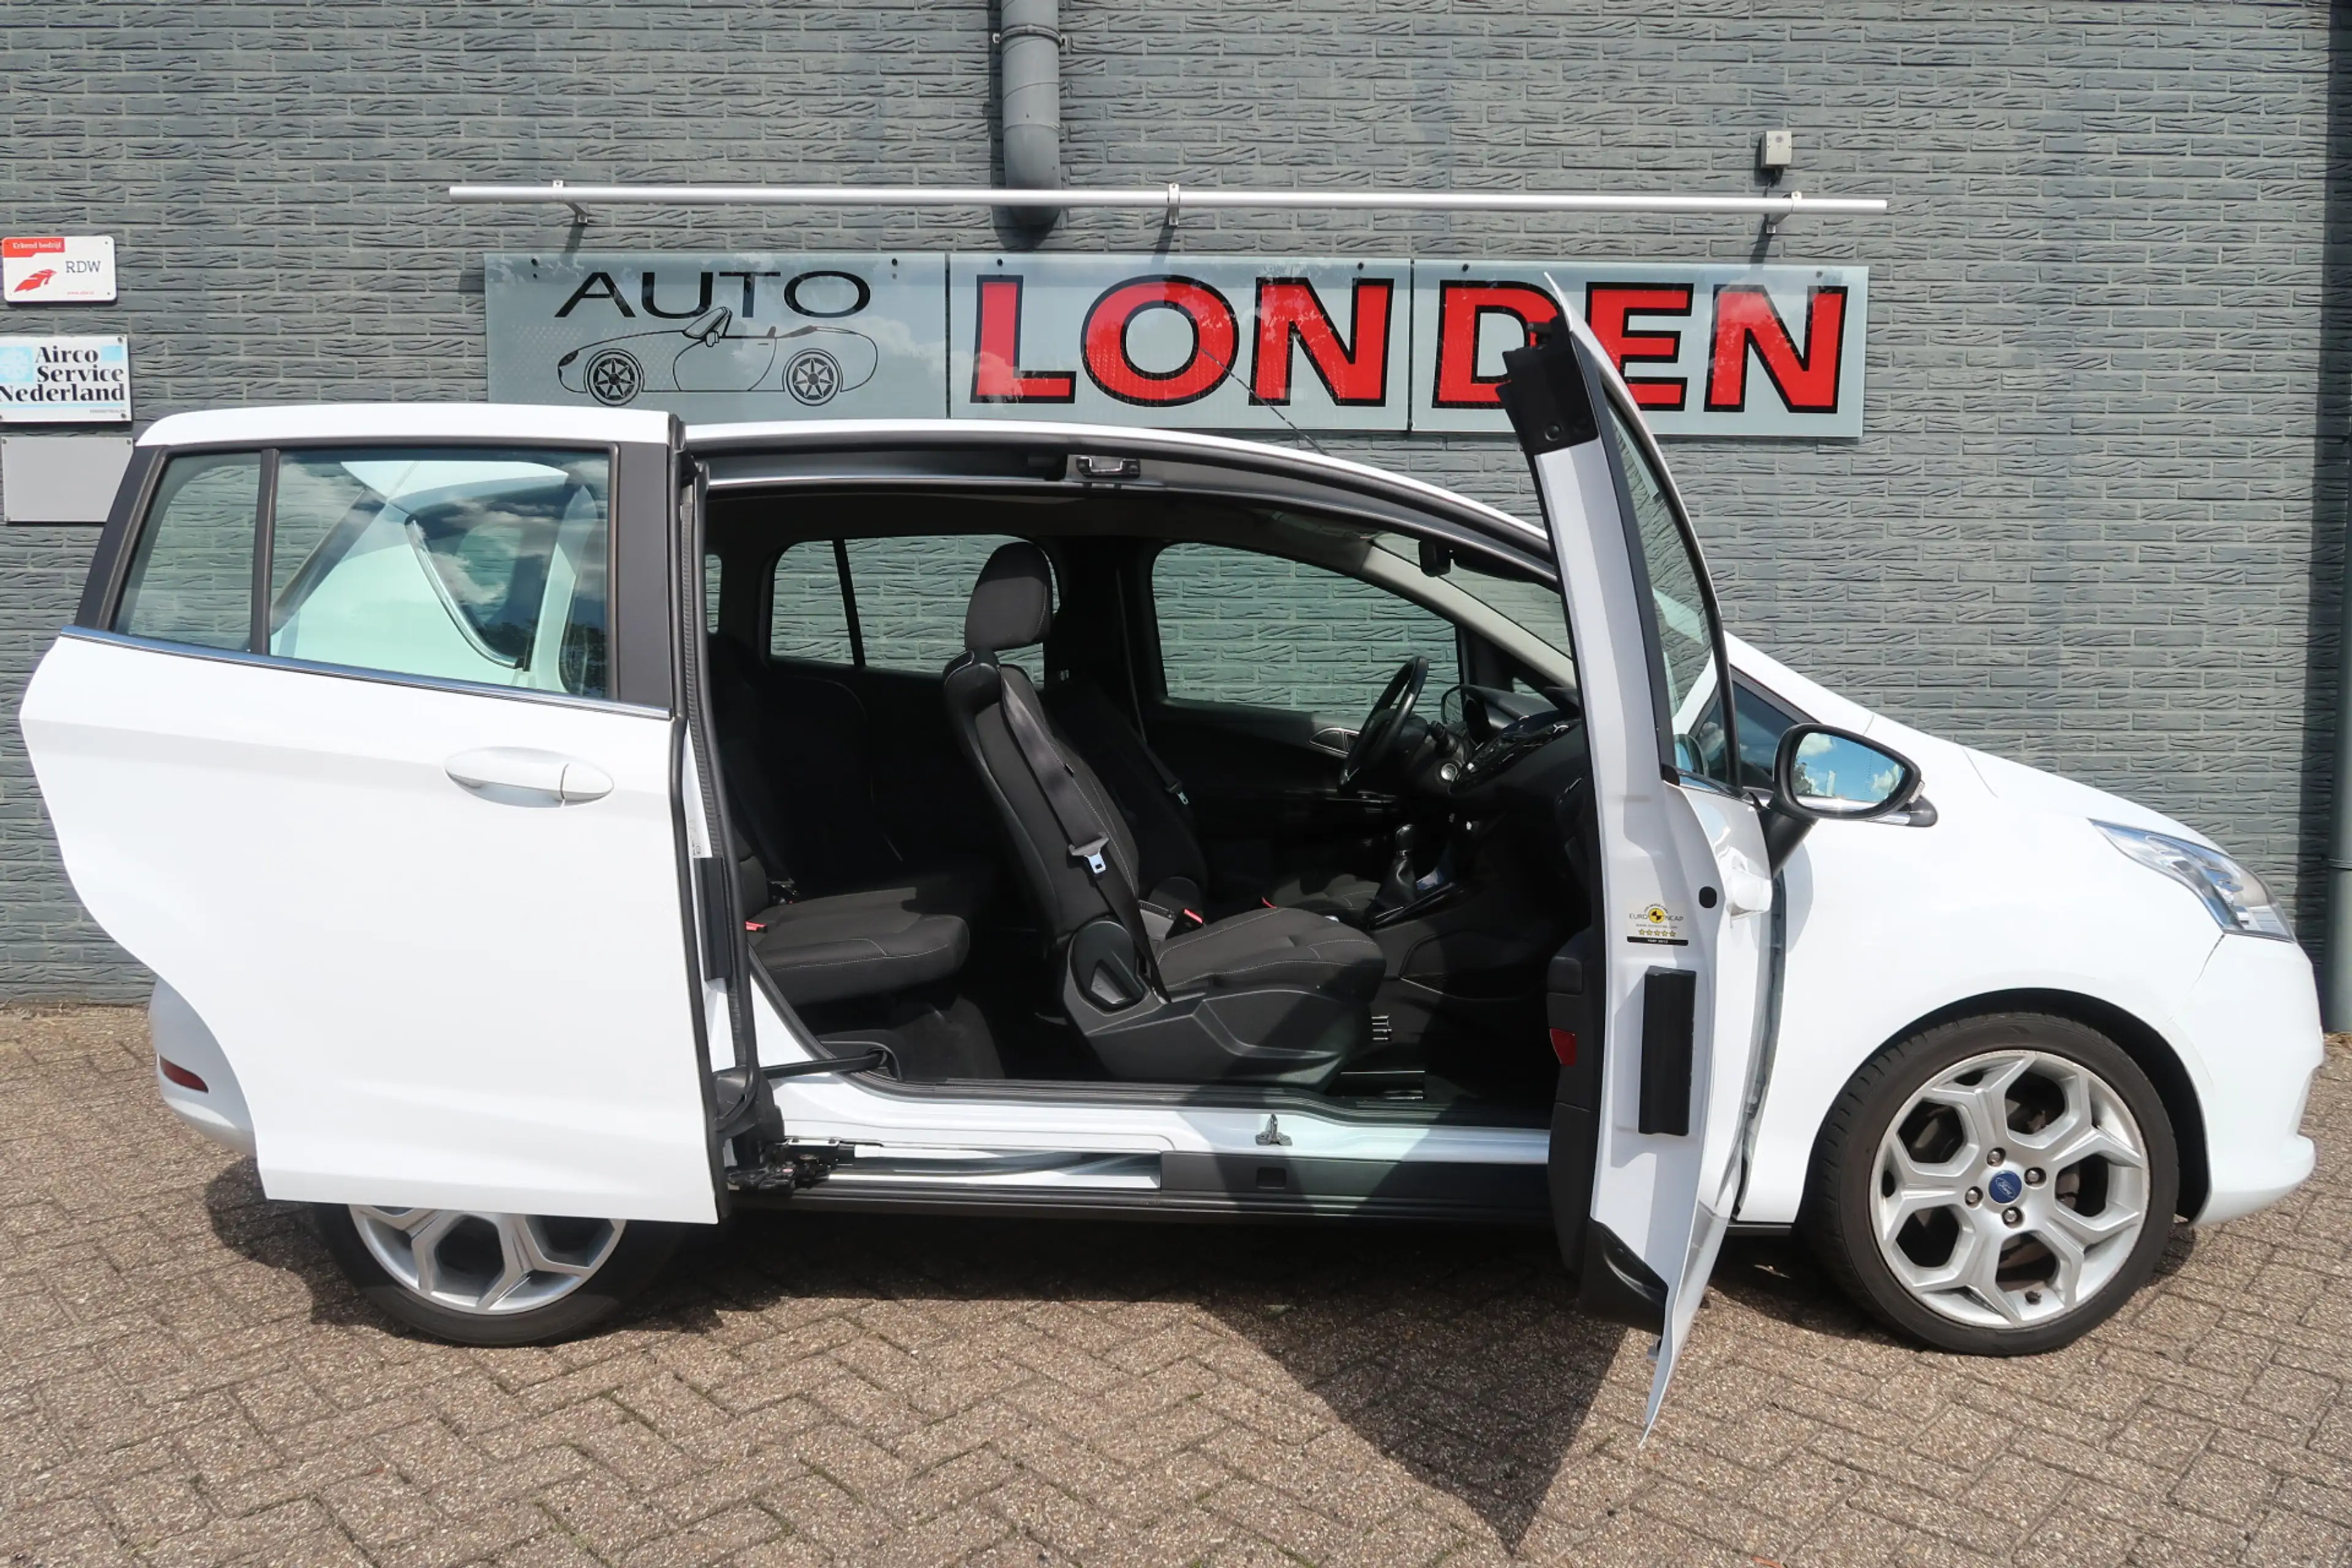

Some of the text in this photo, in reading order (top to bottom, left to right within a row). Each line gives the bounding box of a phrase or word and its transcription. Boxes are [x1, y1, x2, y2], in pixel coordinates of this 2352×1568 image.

[65, 260, 102, 274] RDW
[554, 270, 1849, 414] AUTO LONDEN
[35, 345, 99, 363] Airco
[37, 364, 124, 383] Service
[0, 383, 125, 402] Nederland
